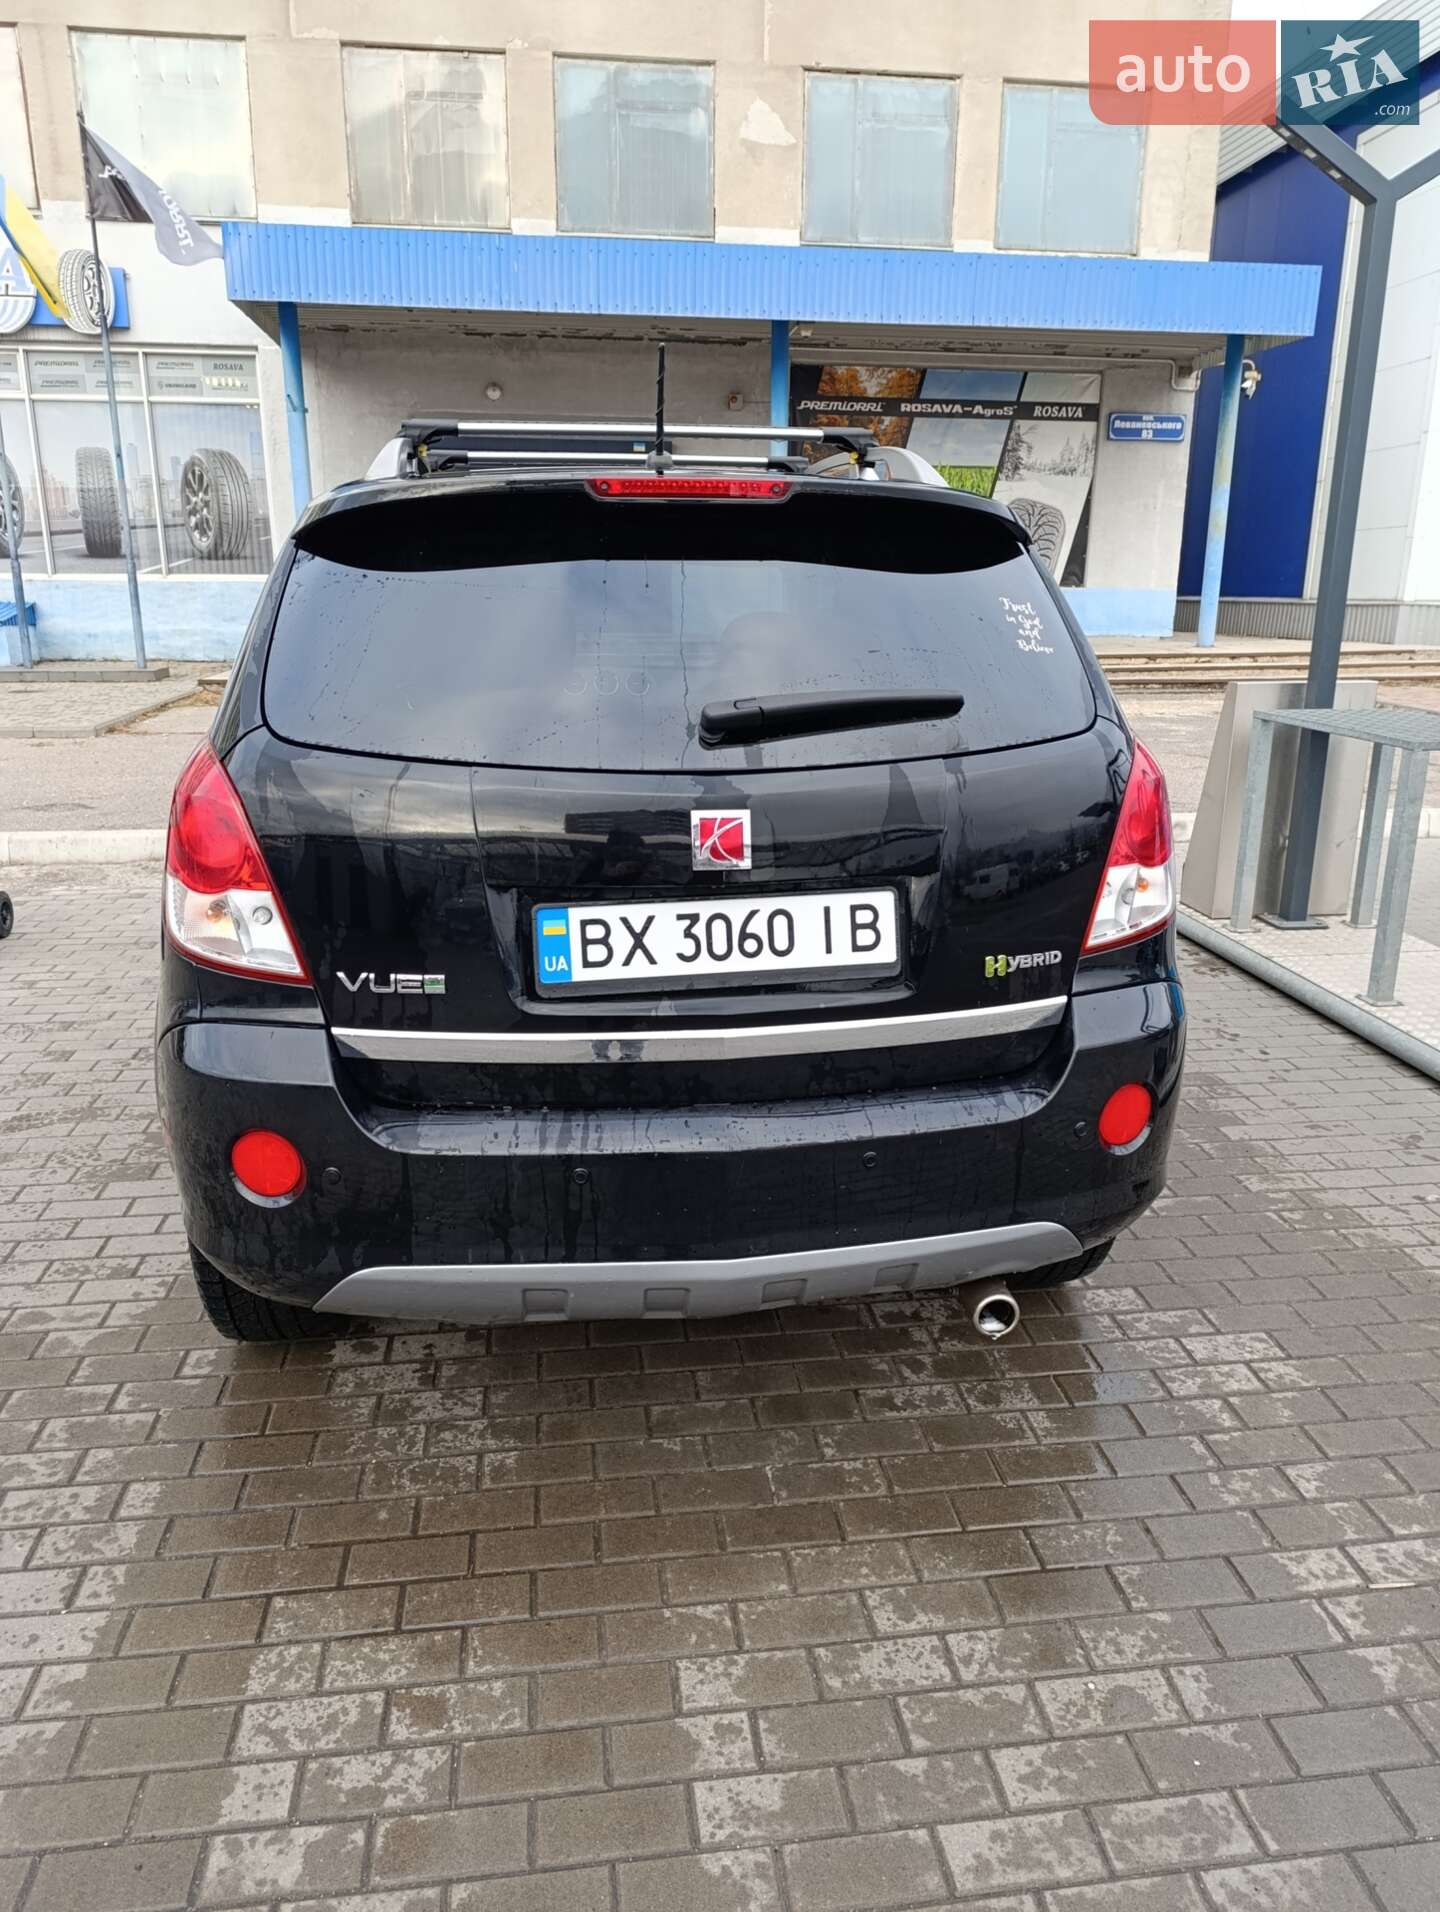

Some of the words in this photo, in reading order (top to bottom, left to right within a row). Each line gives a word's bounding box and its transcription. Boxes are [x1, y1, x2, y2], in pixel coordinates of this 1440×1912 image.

[797, 400, 884, 412] PREMIORRI
[1033, 405, 1084, 418] ROSAVA
[579, 915, 658, 969] BX
[676, 908, 795, 963] 3060
[824, 903, 882, 955] IB
[544, 955, 569, 972] UA
[336, 971, 424, 994] VUE
